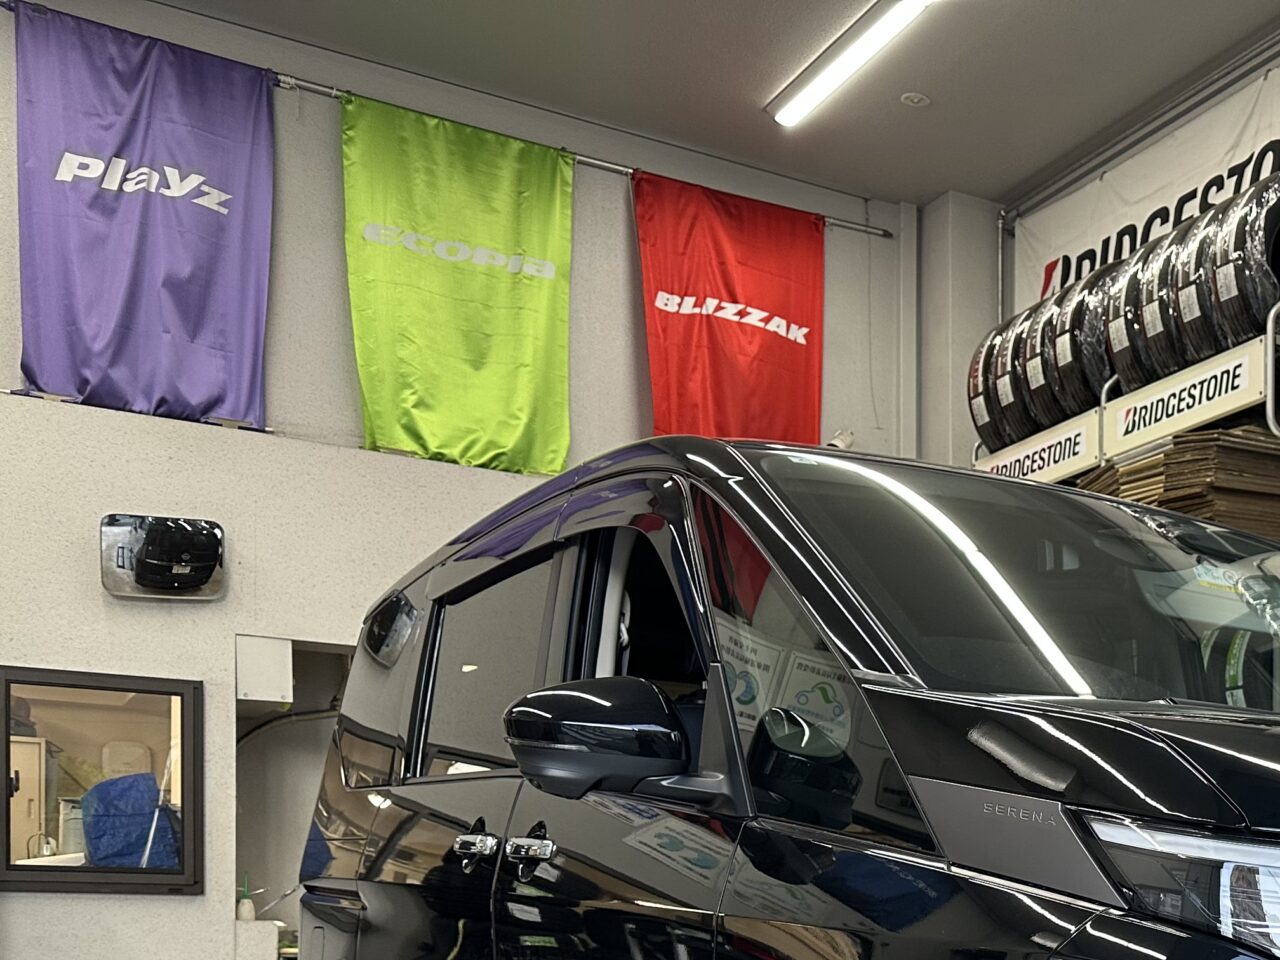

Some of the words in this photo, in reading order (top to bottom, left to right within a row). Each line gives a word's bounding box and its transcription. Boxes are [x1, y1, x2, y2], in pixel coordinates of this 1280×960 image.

[55, 152, 233, 215] Playz
[654, 290, 811, 345] BLIZZAK
[1122, 363, 1243, 437] BRIDGESTONE
[983, 803, 1056, 826] SERENA
